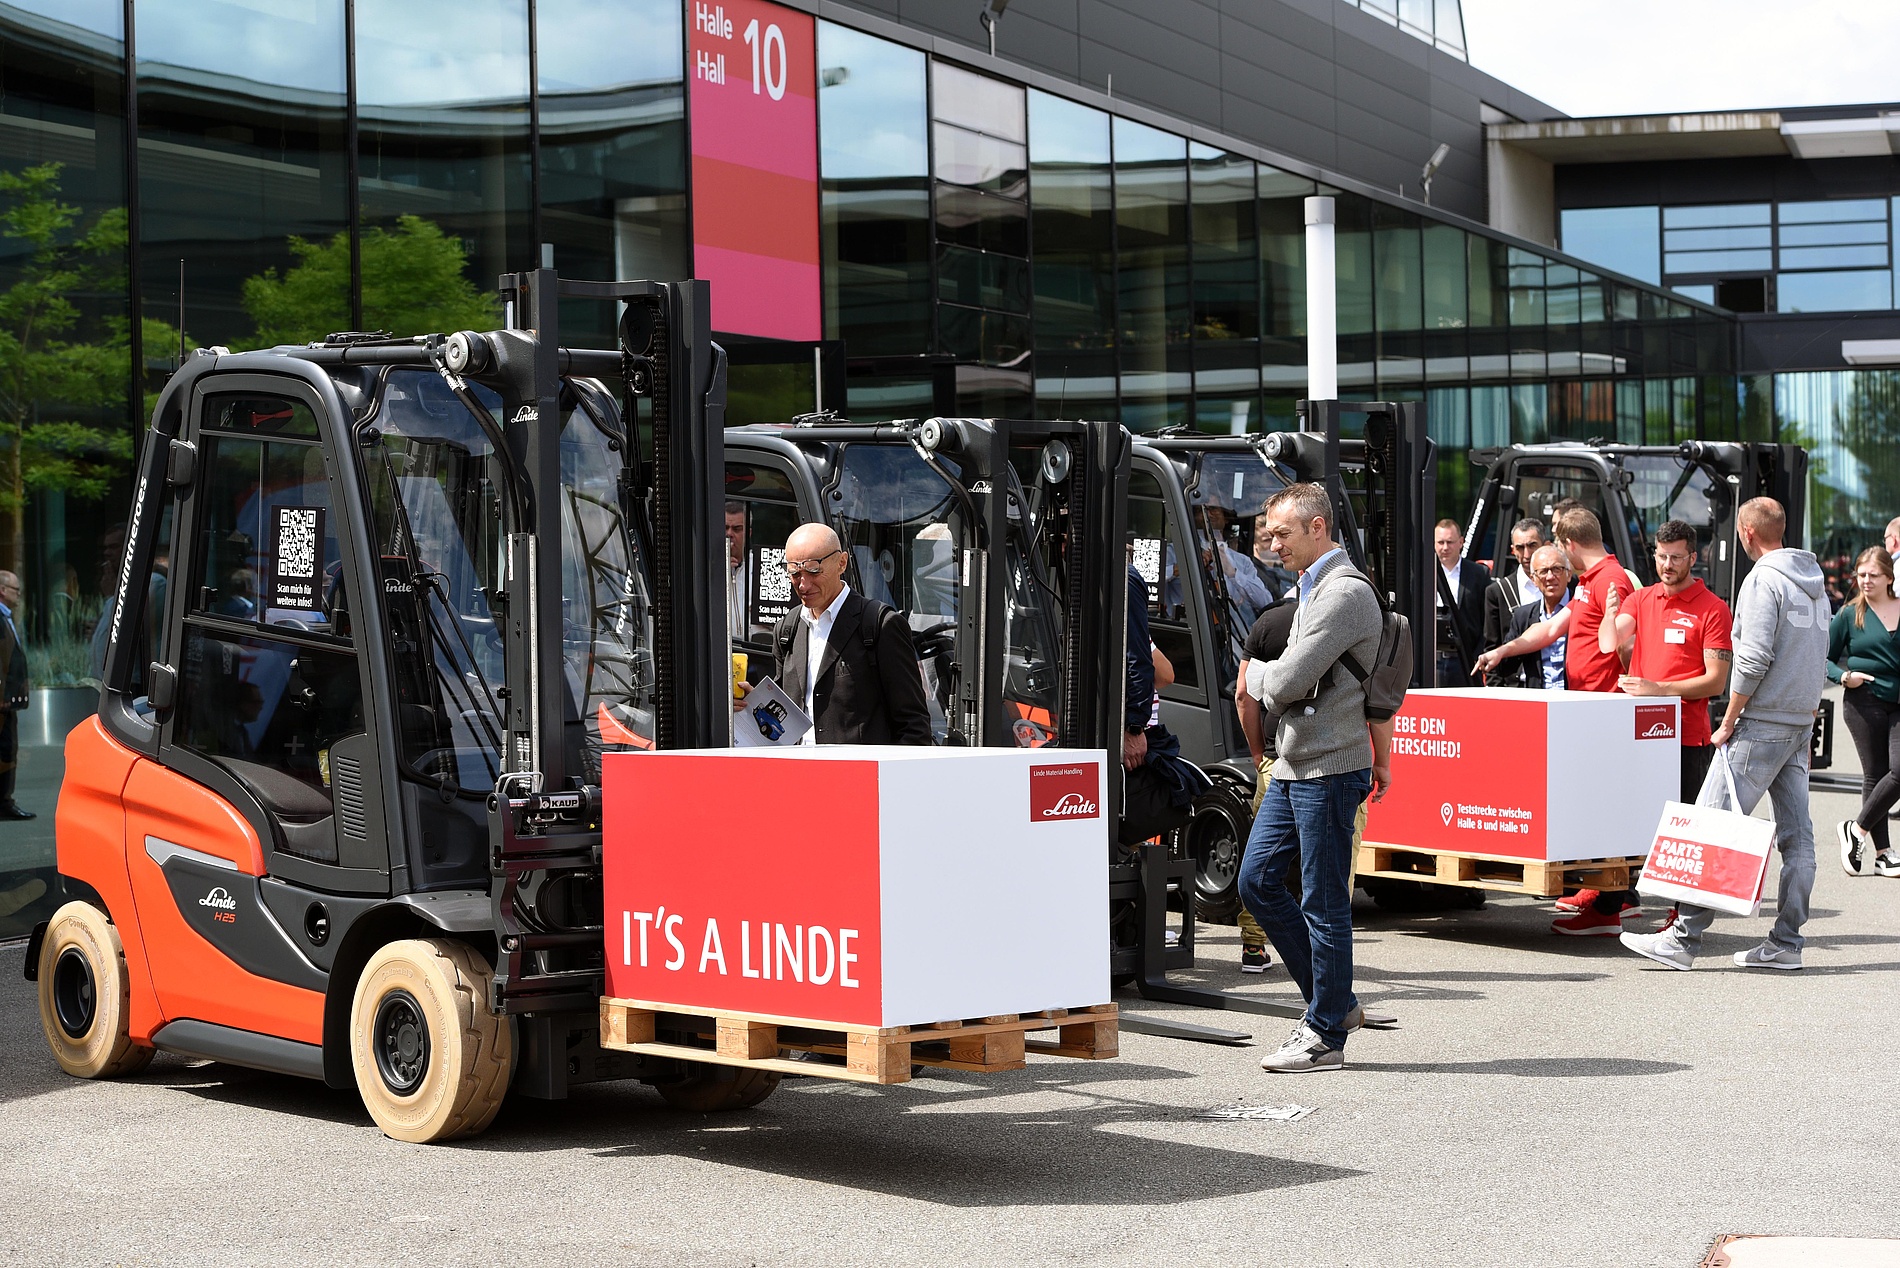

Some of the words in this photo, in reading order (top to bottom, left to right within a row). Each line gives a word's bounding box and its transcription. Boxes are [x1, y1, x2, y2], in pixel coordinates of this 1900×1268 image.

[696, 1, 733, 40] Halle
[743, 18, 787, 101] 10
[697, 49, 725, 86] Hall
[510, 405, 539, 423] Linde
[968, 480, 993, 494] Linde
[277, 583, 290, 593] Scan
[290, 583, 303, 594] mich
[304, 584, 312, 595] für
[276, 596, 297, 606] weitere
[1393, 715, 1417, 734] EBE
[1420, 717, 1446, 736] DEN
[1641, 722, 1674, 737] Linde
[1390, 737, 1461, 759] TERSCHIED!
[1064, 768, 1083, 776] Handling
[1043, 793, 1096, 816] Linde
[1457, 803, 1497, 816] Teststrecke
[1498, 807, 1532, 820] zwischen
[1457, 818, 1476, 829] Halle
[1477, 819, 1482, 830] 8
[1484, 820, 1498, 831] und
[1499, 821, 1518, 833] Halle
[1519, 823, 1529, 834] 10
[1670, 816, 1692, 827] TVH
[1660, 839, 1704, 860] PARTS
[1655, 853, 1705, 875] &MORE
[198, 886, 236, 910] Linde
[213, 911, 236, 923] H25
[623, 906, 685, 971] IT'S
[699, 917, 728, 976] A
[741, 920, 860, 989] LINDE
